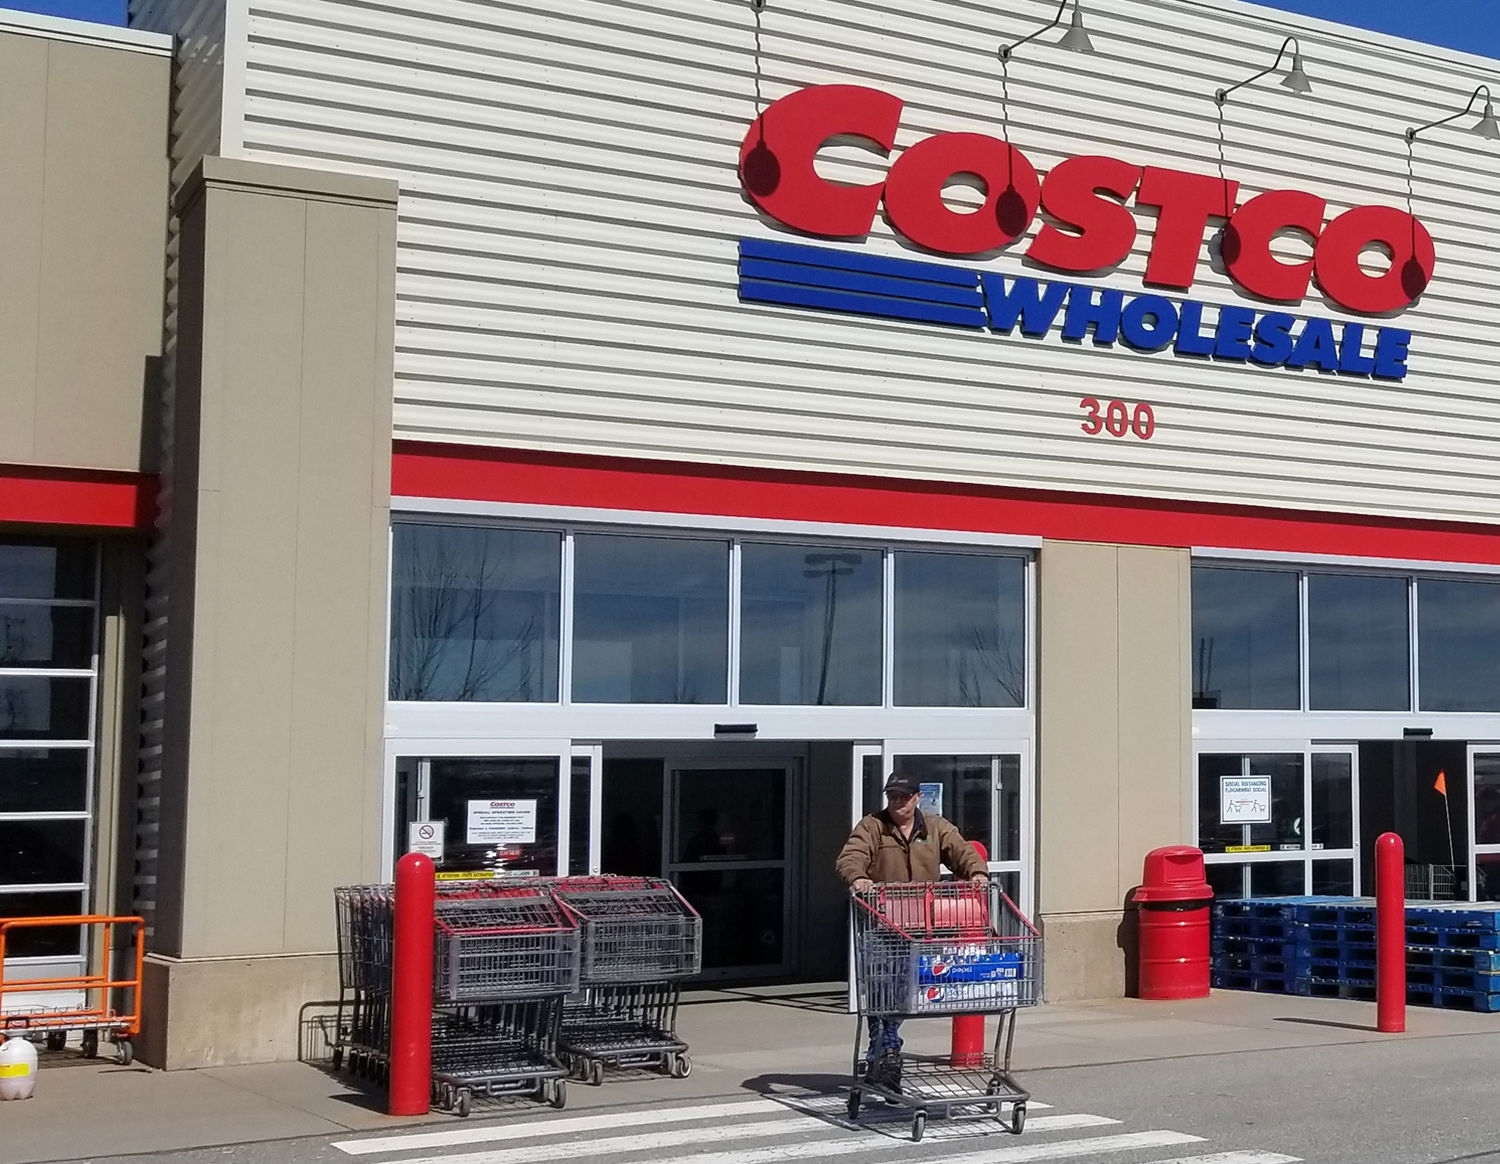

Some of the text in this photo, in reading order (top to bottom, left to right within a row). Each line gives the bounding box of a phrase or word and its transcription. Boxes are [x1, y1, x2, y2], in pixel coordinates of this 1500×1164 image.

[739, 84, 1435, 313] COSTCO
[978, 271, 1412, 382] WHOLESALE
[1080, 396, 1155, 440] 300
